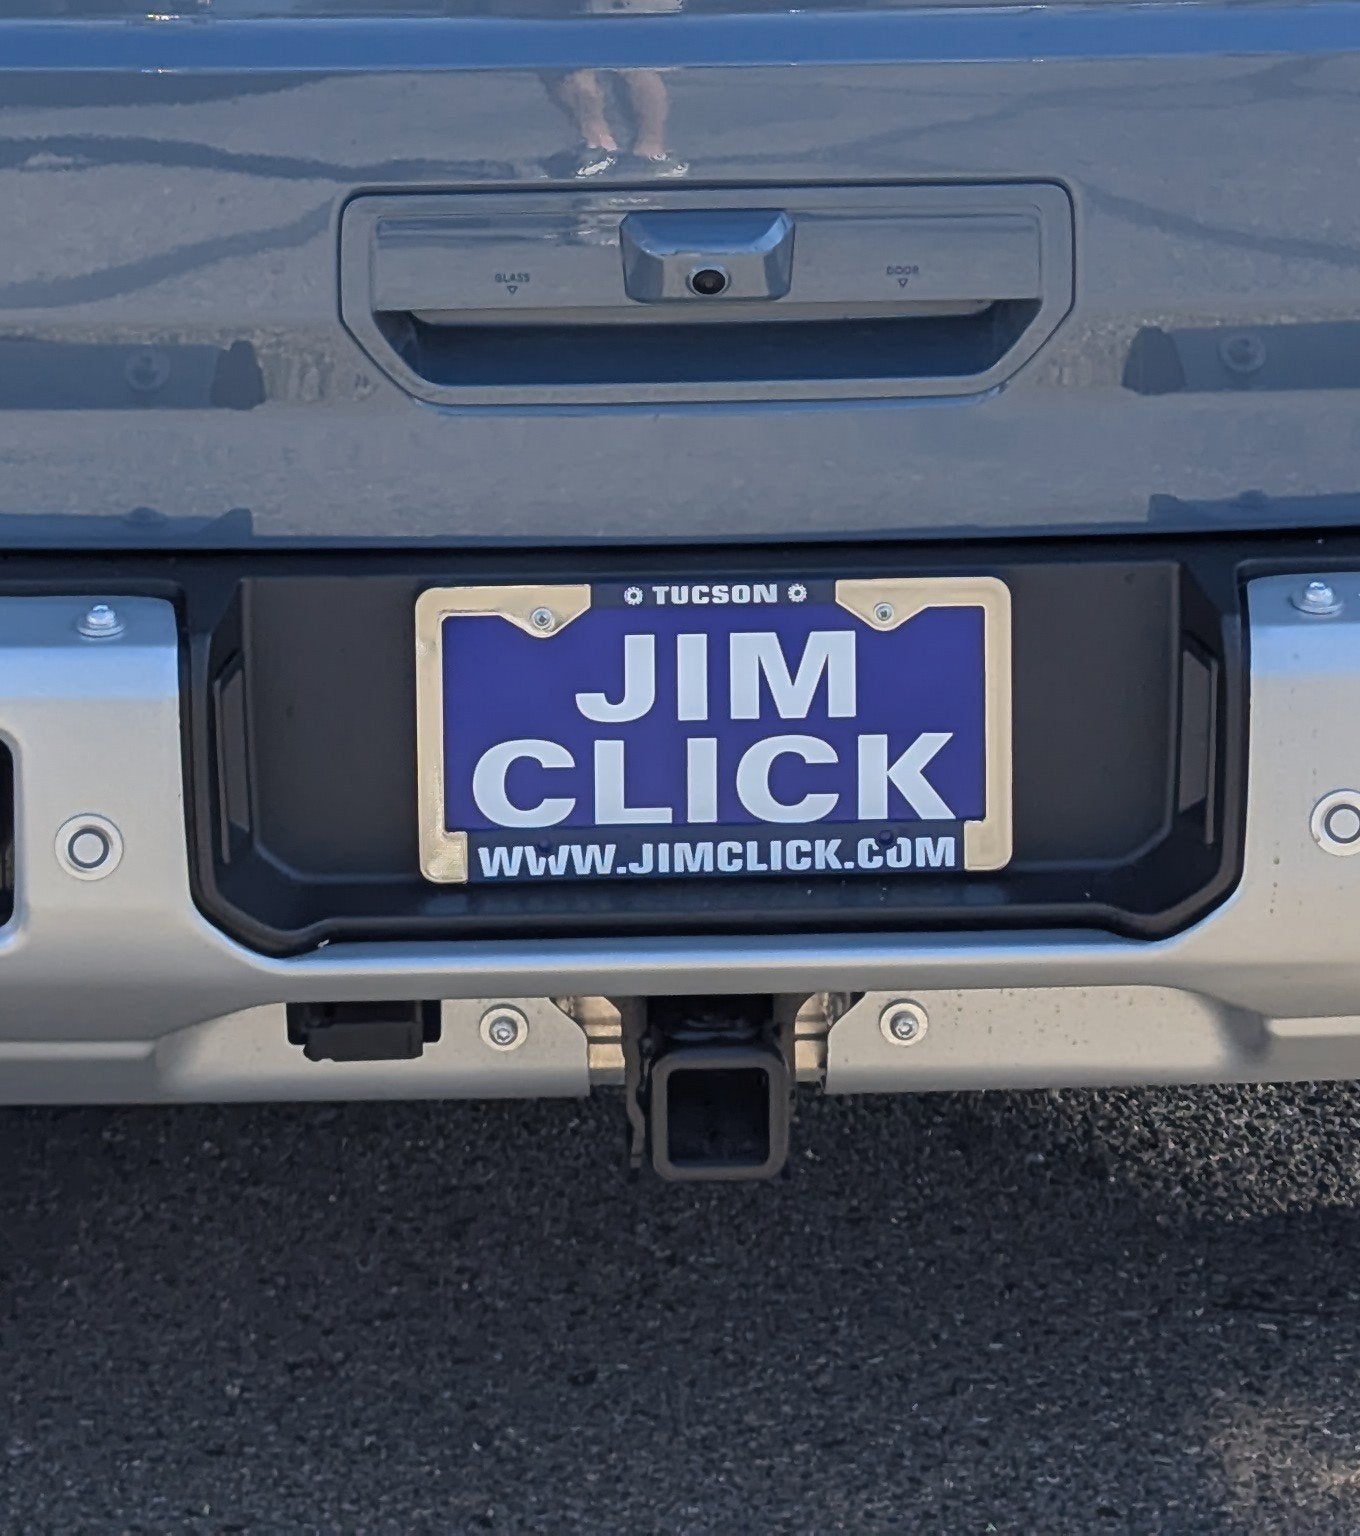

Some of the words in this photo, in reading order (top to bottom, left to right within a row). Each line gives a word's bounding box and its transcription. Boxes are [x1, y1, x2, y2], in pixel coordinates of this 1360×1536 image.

[652, 583, 777, 605] TUCSON
[575, 630, 857, 723] JIM
[472, 732, 957, 828] CLICK
[477, 837, 956, 878] WWW.JIMCLICK.COM
